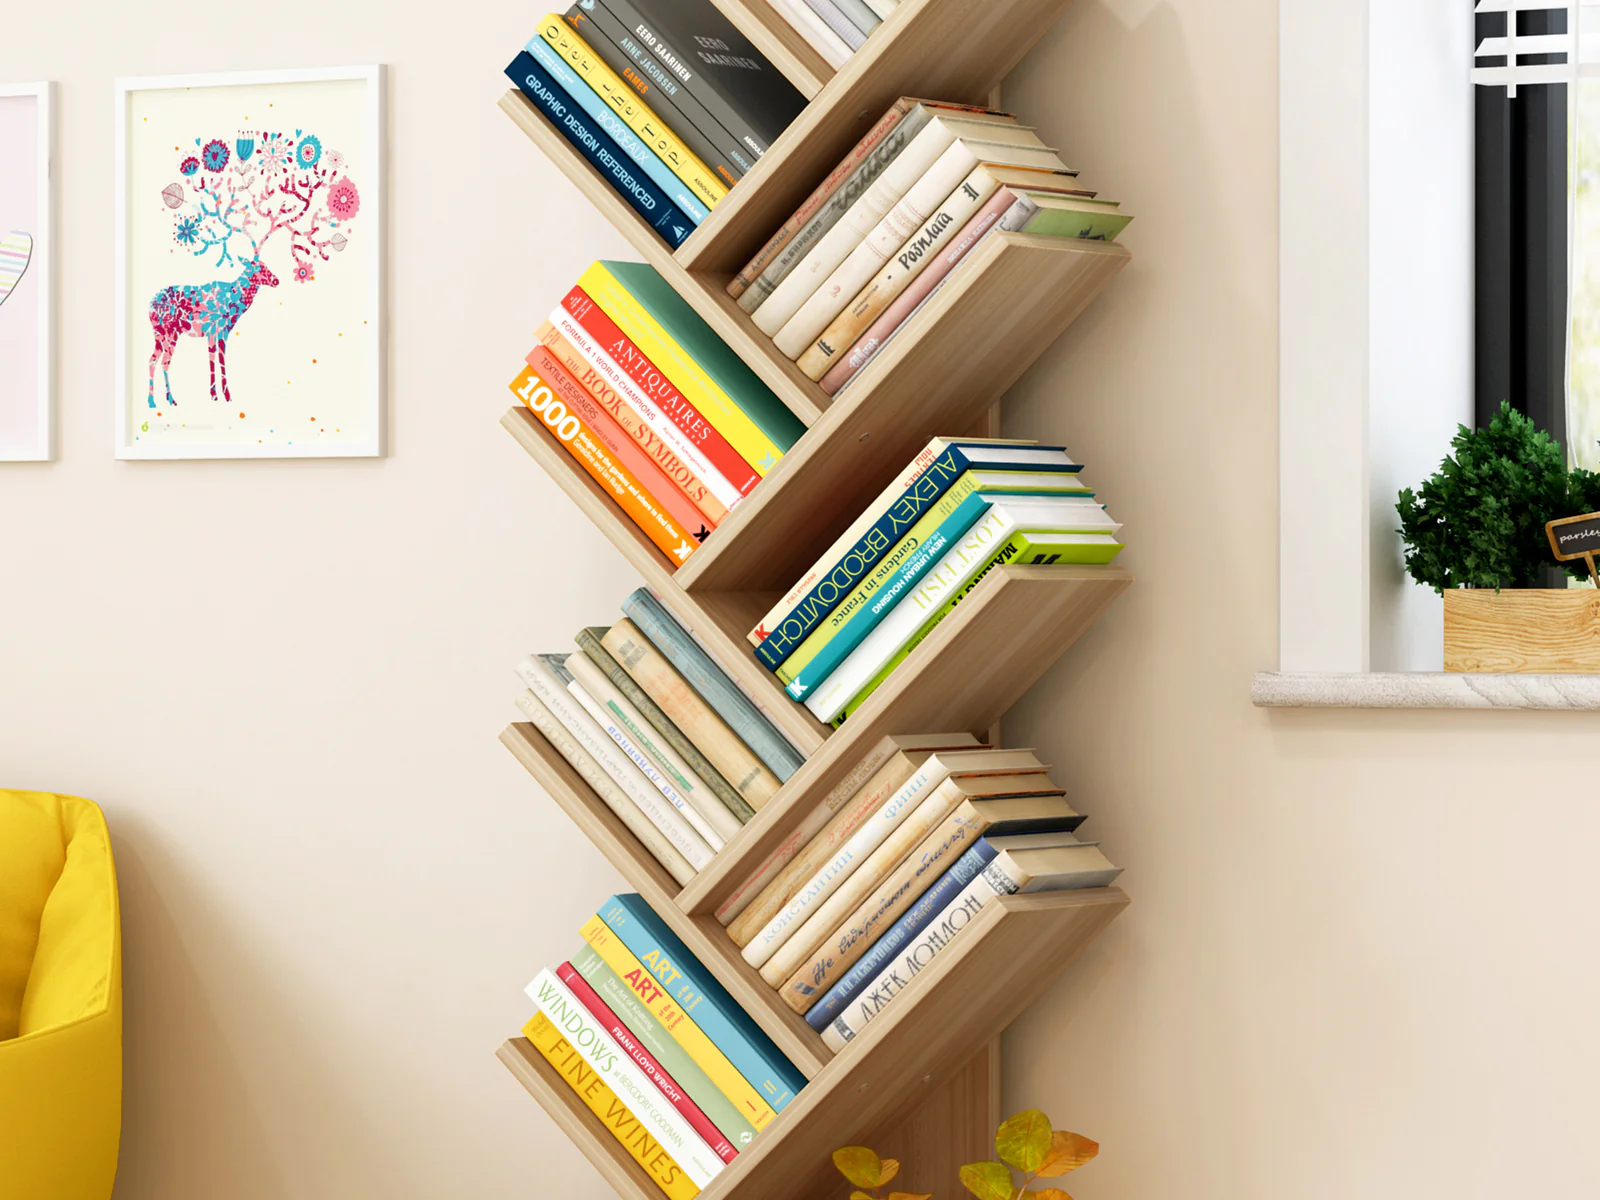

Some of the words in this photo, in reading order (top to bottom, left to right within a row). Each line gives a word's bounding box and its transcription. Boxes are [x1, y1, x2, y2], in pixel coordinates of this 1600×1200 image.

[619, 36, 642, 59] ARNE
[638, 56, 677, 95] JACOBSEN
[634, 23, 657, 46] EERO
[653, 42, 691, 81] SAARINEN
[693, 34, 730, 52] EERO
[697, 50, 762, 71] SAARINEN
[621, 66, 649, 94] EAMES
[523, 73, 567, 117] GRAPHIC
[562, 114, 600, 151] DESIGN
[596, 148, 657, 210] REFERENCED
[595, 109, 649, 164] BORDEAUX
[693, 177, 718, 202] ASSOULINE
[538, 356, 566, 385] TEXTILE
[562, 381, 599, 419] DESIGNERS
[560, 319, 592, 353] FORMULA
[594, 356, 620, 382] WORLD
[617, 379, 656, 420] CHAMPIONS
[608, 347, 634, 374] PARIS
[661, 404, 701, 445] MARKETS
[612, 336, 712, 440] ANTIQUAIRES
[514, 372, 584, 443] 1000
[563, 355, 581, 374] THE
[579, 367, 628, 417] BOOK
[620, 416, 633, 429] OF
[632, 422, 708, 503] SYMBOLS
[571, 438, 596, 463] Geraldine
[592, 460, 604, 472] and
[576, 430, 599, 453] designs
[594, 448, 606, 460] for
[601, 456, 613, 468] the
[627, 483, 639, 496] and
[635, 492, 654, 511] where
[649, 508, 658, 517] to
[654, 512, 668, 526] find
[664, 523, 680, 539] them
[881, 450, 962, 534] ALEXEY
[874, 535, 920, 582] Gardens
[899, 549, 922, 573] FRENCH
[902, 552, 930, 581] URBAN
[920, 530, 940, 551] HILARY
[926, 535, 946, 556] NEW
[950, 512, 1004, 568] LOST
[767, 526, 890, 654] BRODOVITCH
[830, 590, 867, 629] France
[864, 577, 880, 593] in
[870, 578, 906, 614] HOUSING
[911, 561, 958, 610] FISH
[762, 849, 853, 944] КОНСТАНТИН
[622, 964, 664, 1007] ART
[640, 945, 682, 988] ART
[533, 979, 619, 1073] WINDOWS
[605, 976, 620, 991] The
[616, 988, 628, 1000] Art
[624, 997, 634, 1007] of
[630, 1004, 654, 1030] Knitting
[666, 1013, 684, 1031] Century
[610, 1026, 636, 1052] FRANK
[631, 1049, 656, 1074] LLOYD
[651, 1071, 682, 1103] WRIGHT
[547, 1038, 605, 1100] FINE
[601, 1098, 683, 1186] WINES
